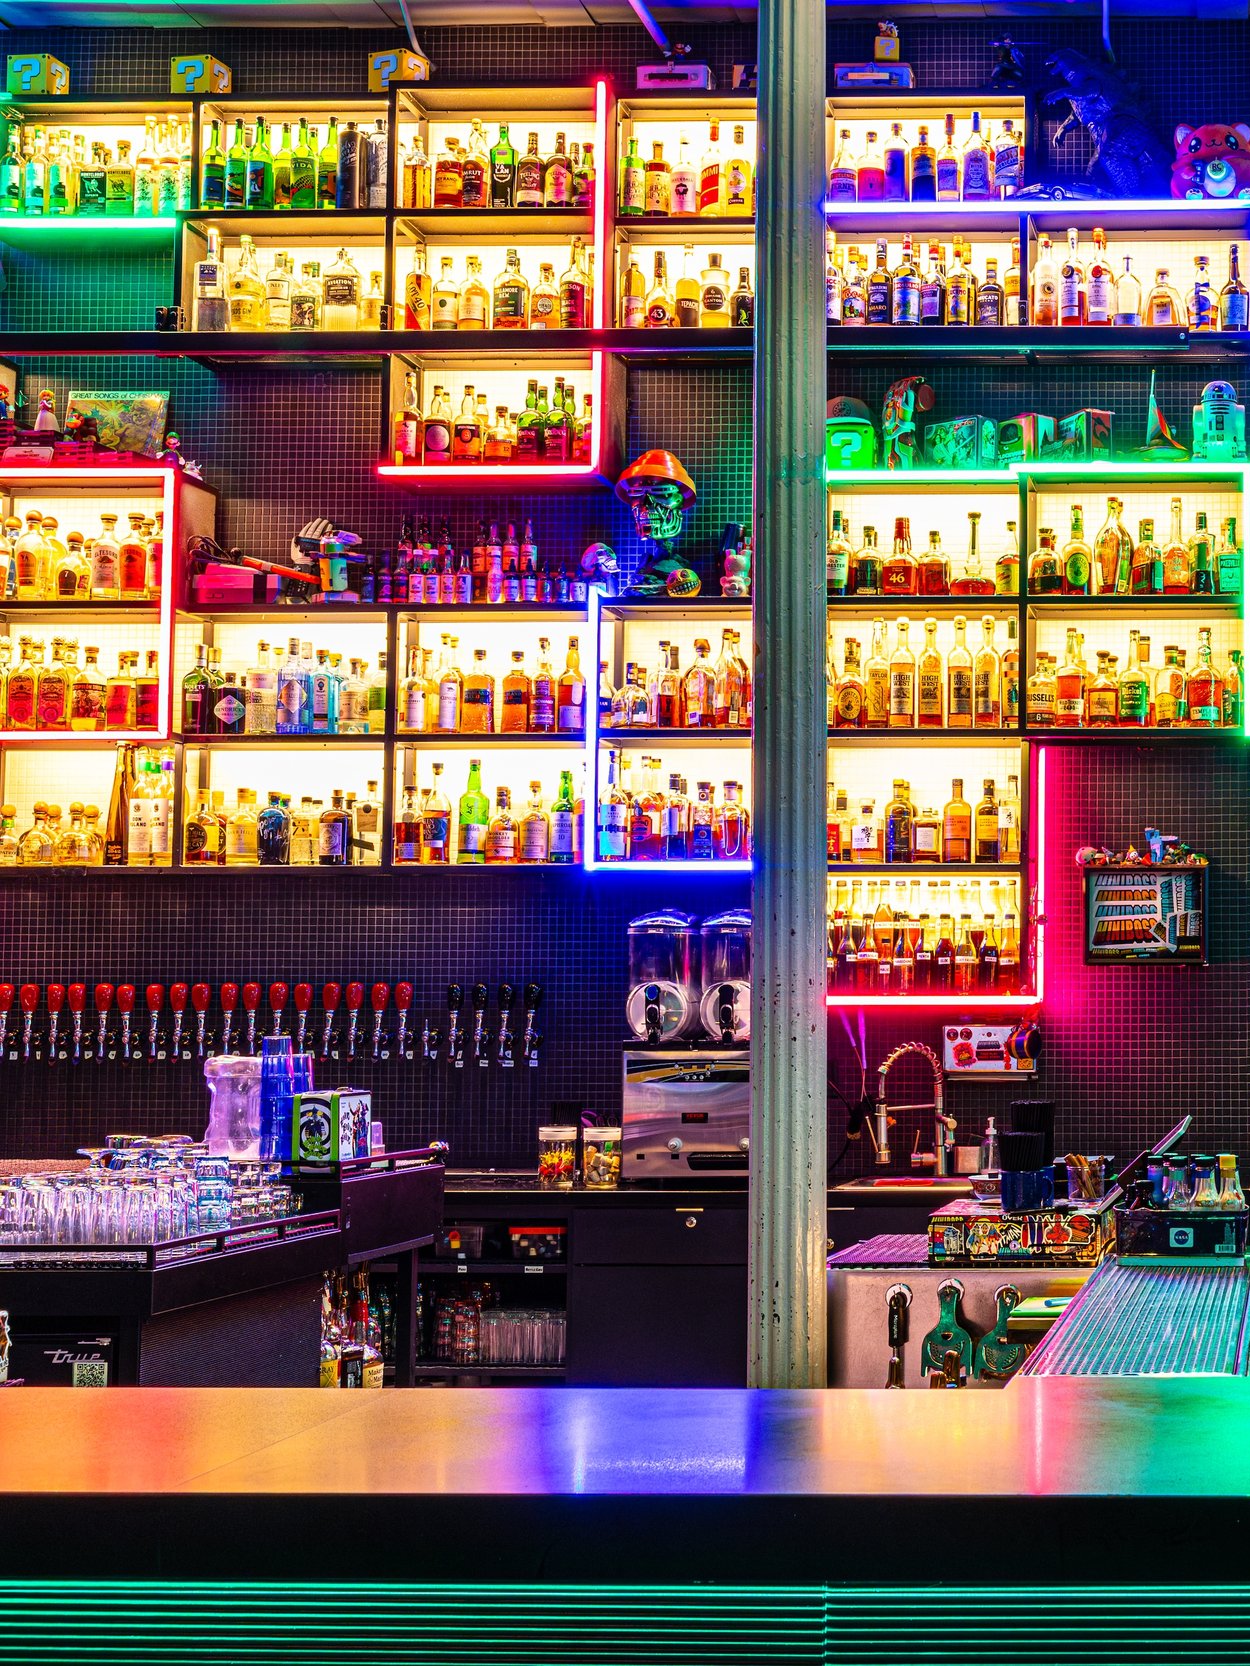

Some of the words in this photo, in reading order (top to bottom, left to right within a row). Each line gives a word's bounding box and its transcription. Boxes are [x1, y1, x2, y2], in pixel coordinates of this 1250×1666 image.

[414, 297, 426, 310] 40
[650, 308, 664, 319] 43
[890, 572, 905, 584] 46
[1036, 713, 1041, 721] 6
[1095, 874, 1157, 886] MINIBOSS
[1095, 890, 1158, 902] MINIBOSS
[1095, 905, 1158, 917] MINIBOSS
[1092, 918, 1159, 943] MINIBOSS
[43, 1349, 105, 1364] true
